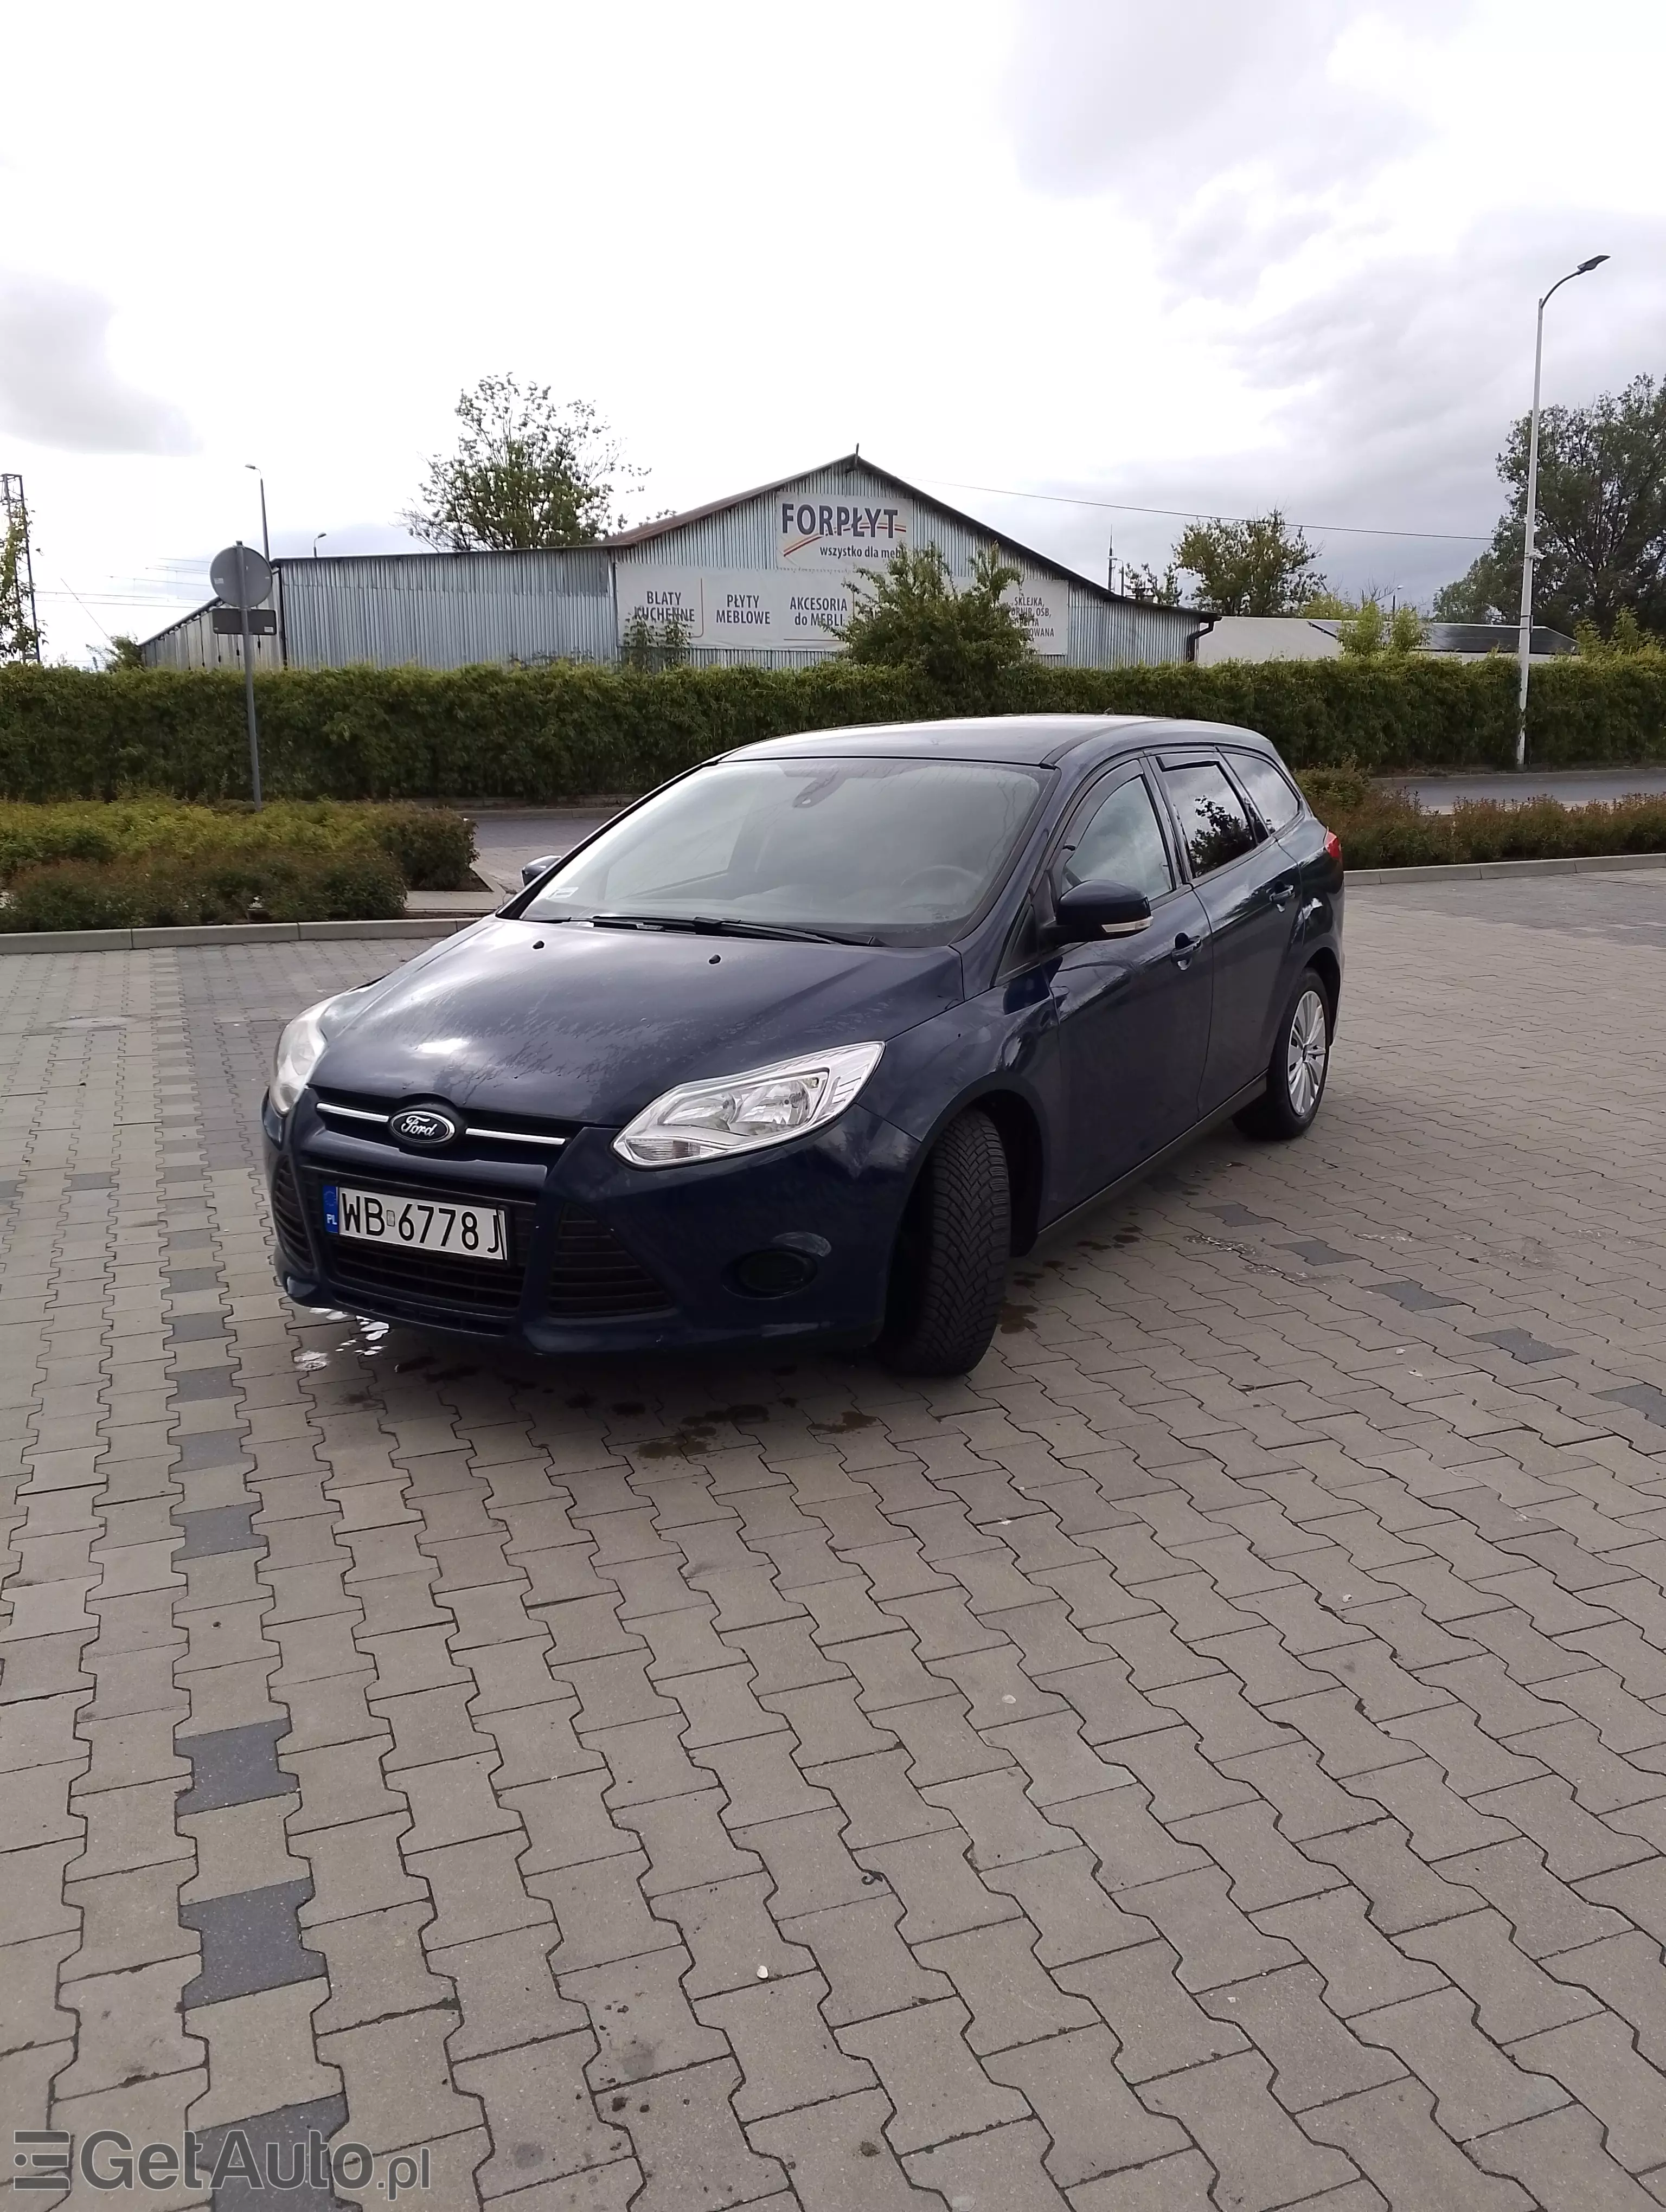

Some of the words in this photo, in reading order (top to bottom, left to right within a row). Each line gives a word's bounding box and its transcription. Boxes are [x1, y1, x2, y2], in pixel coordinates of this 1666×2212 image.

[782, 503, 898, 538] FORPŁYT
[820, 545, 862, 560] wszystko
[864, 545, 879, 558] dla
[646, 590, 681, 606] BLATY
[727, 594, 760, 608] PŁYTY
[790, 596, 848, 612] AKCESORIA
[1014, 596, 1045, 607] SKLEJKA,
[716, 609, 771, 625] MEBLOWE
[794, 612, 808, 626] do
[810, 613, 843, 627] MEBLI
[401, 1115, 438, 1137] Ford
[326, 1213, 338, 1225] PL
[341, 1192, 386, 1237] WB
[398, 1203, 499, 1254] 6778J
